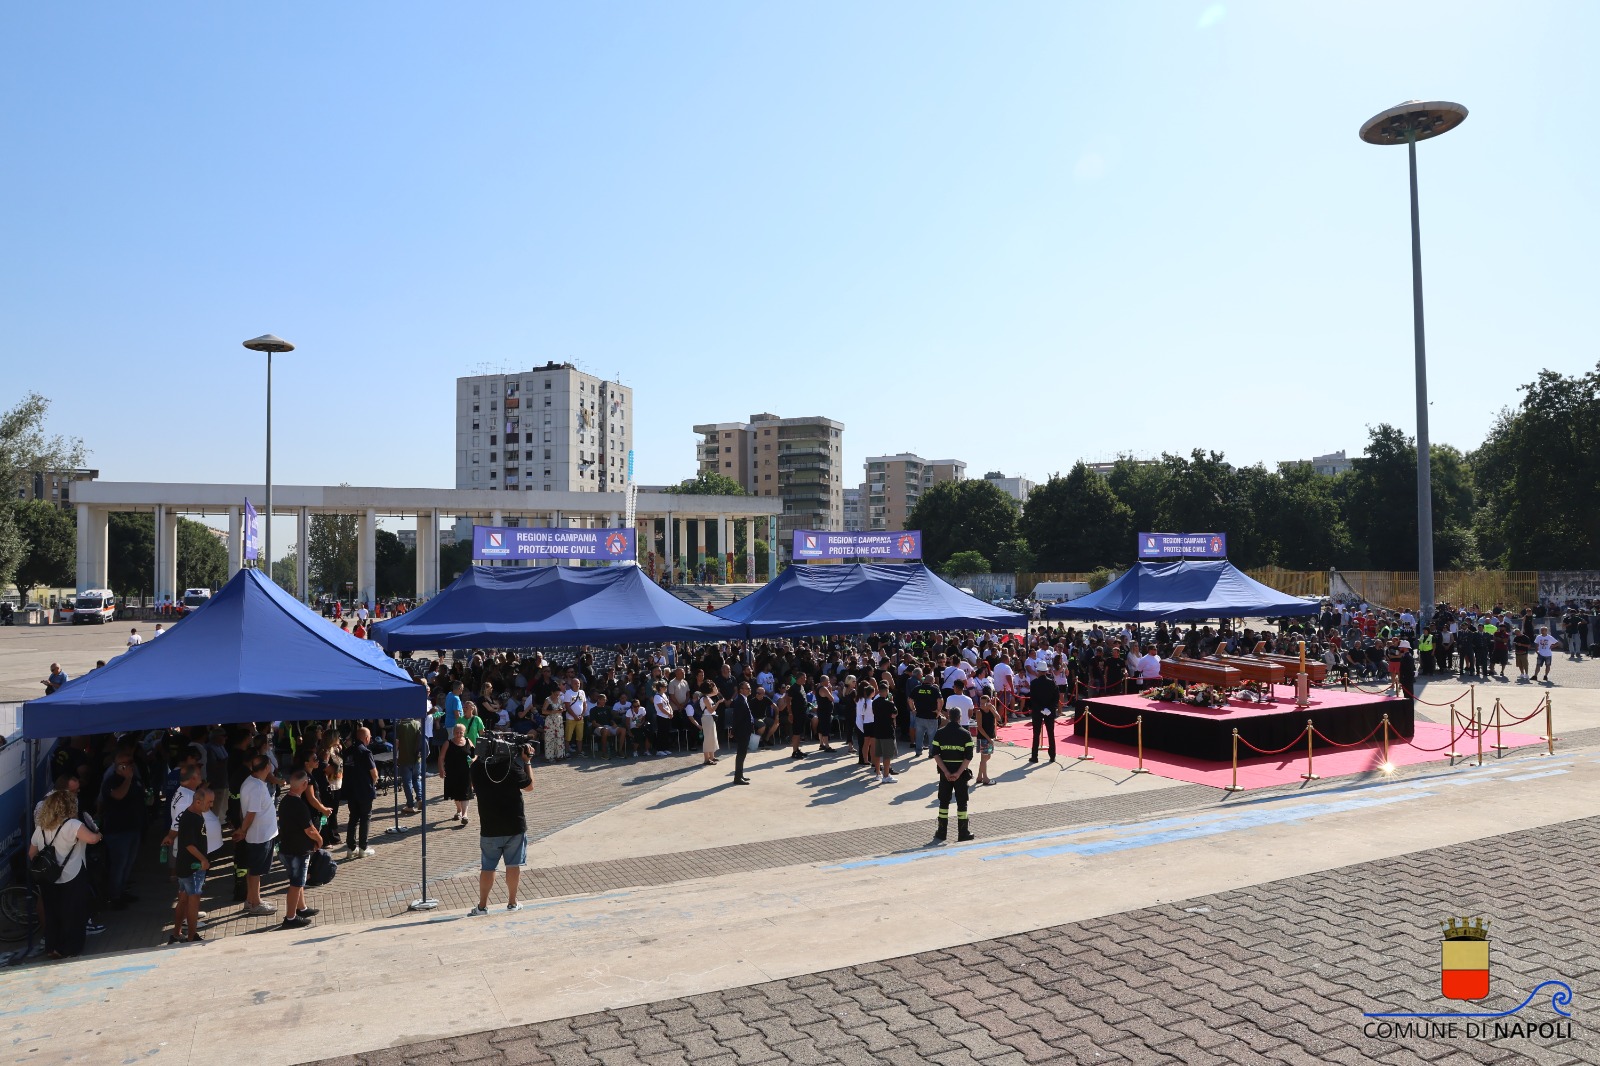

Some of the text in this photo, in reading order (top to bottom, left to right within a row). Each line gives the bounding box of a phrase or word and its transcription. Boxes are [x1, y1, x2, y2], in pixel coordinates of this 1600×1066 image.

[517, 532, 597, 542] REGIONE CAMPANIA
[828, 536, 891, 544] REGIONE CAMPANIA
[518, 545, 568, 554] PROTEZIONE
[571, 545, 596, 554] CIVILE
[829, 546, 869, 554] PROTEZIONE
[870, 546, 890, 554] CIVILE
